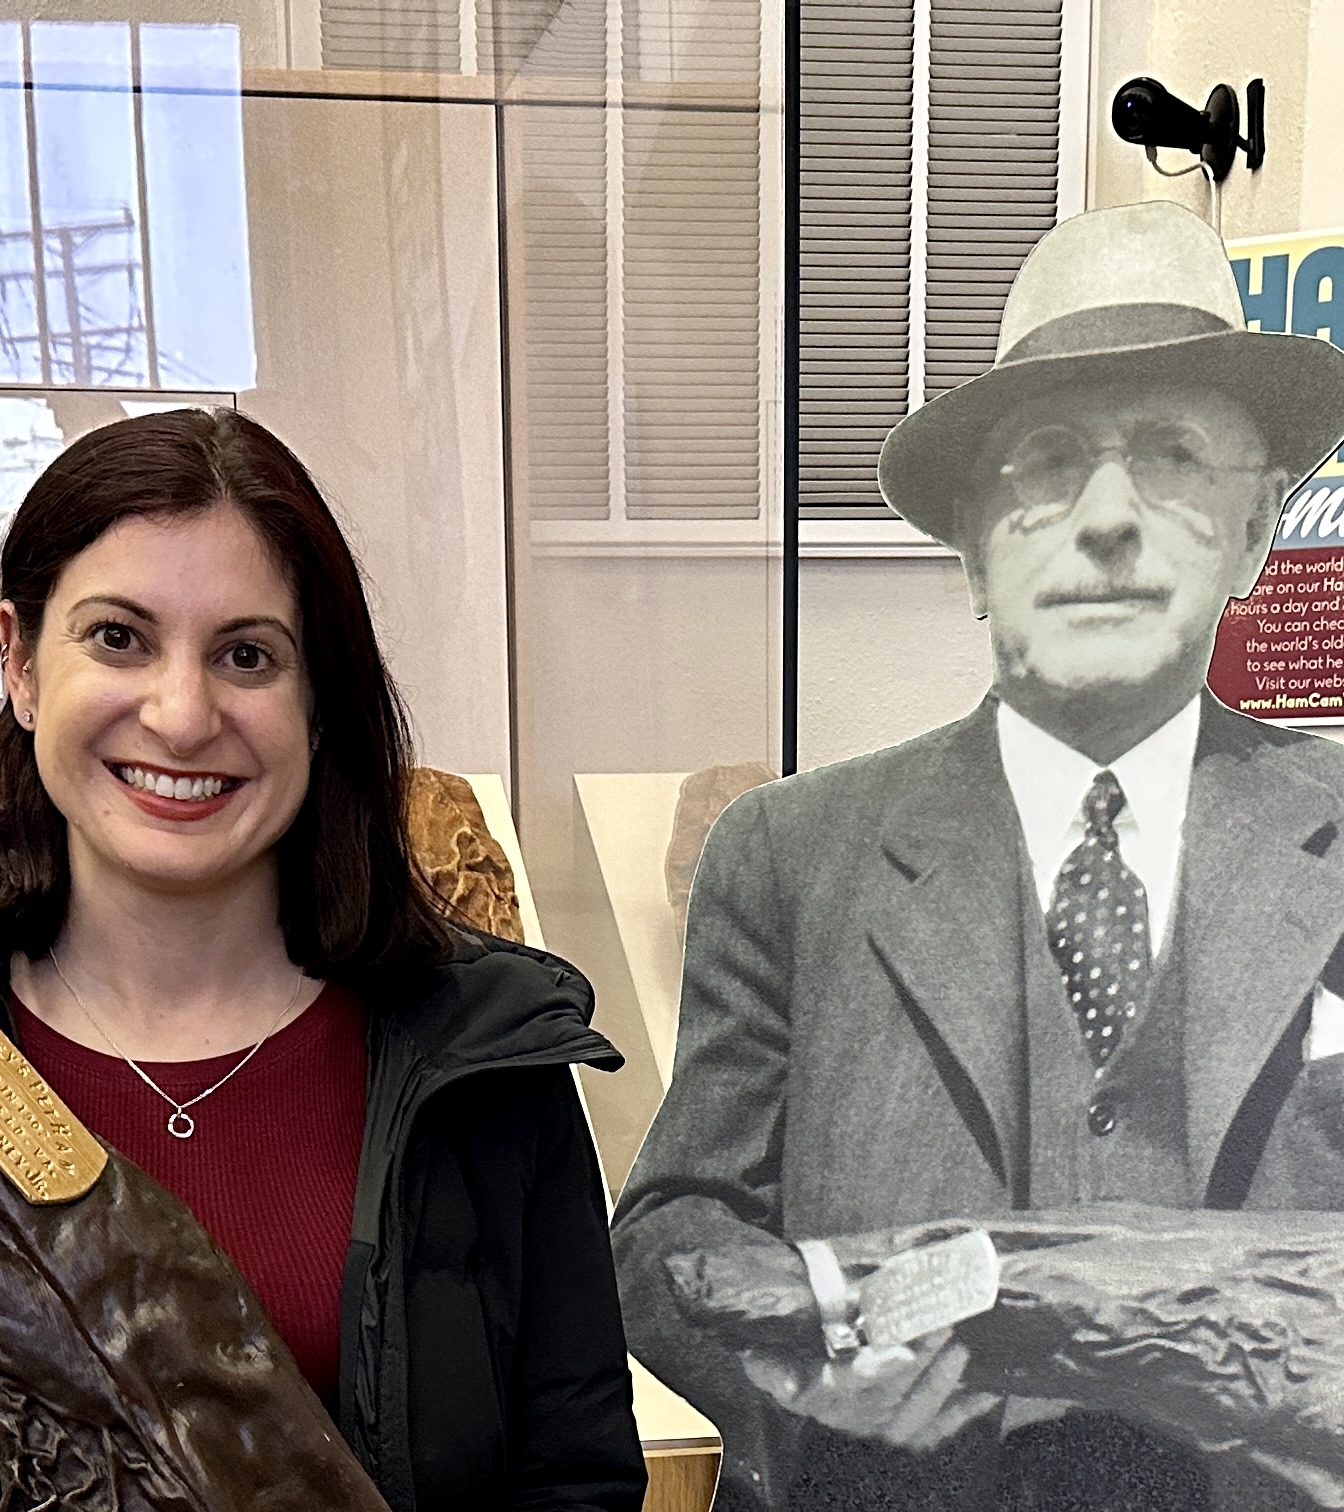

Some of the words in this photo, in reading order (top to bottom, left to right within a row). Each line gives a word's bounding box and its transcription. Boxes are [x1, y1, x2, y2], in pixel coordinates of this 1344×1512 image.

[1281, 560, 1303, 574] the
[1254, 583, 1273, 595] are
[1277, 583, 1294, 593] on
[1297, 582, 1320, 592] our
[1231, 602, 1267, 615] hours
[1271, 603, 1279, 613] a
[1283, 600, 1307, 616] day
[1312, 598, 1339, 612] and
[1257, 619, 1280, 633] You
[1284, 622, 1309, 632] can
[1246, 639, 1267, 652] the
[1271, 636, 1318, 651] world's
[1247, 659, 1260, 672] to
[1263, 660, 1285, 671] see
[1289, 656, 1323, 670] what
[1256, 676, 1285, 690] Visit
[1289, 678, 1310, 688] our
